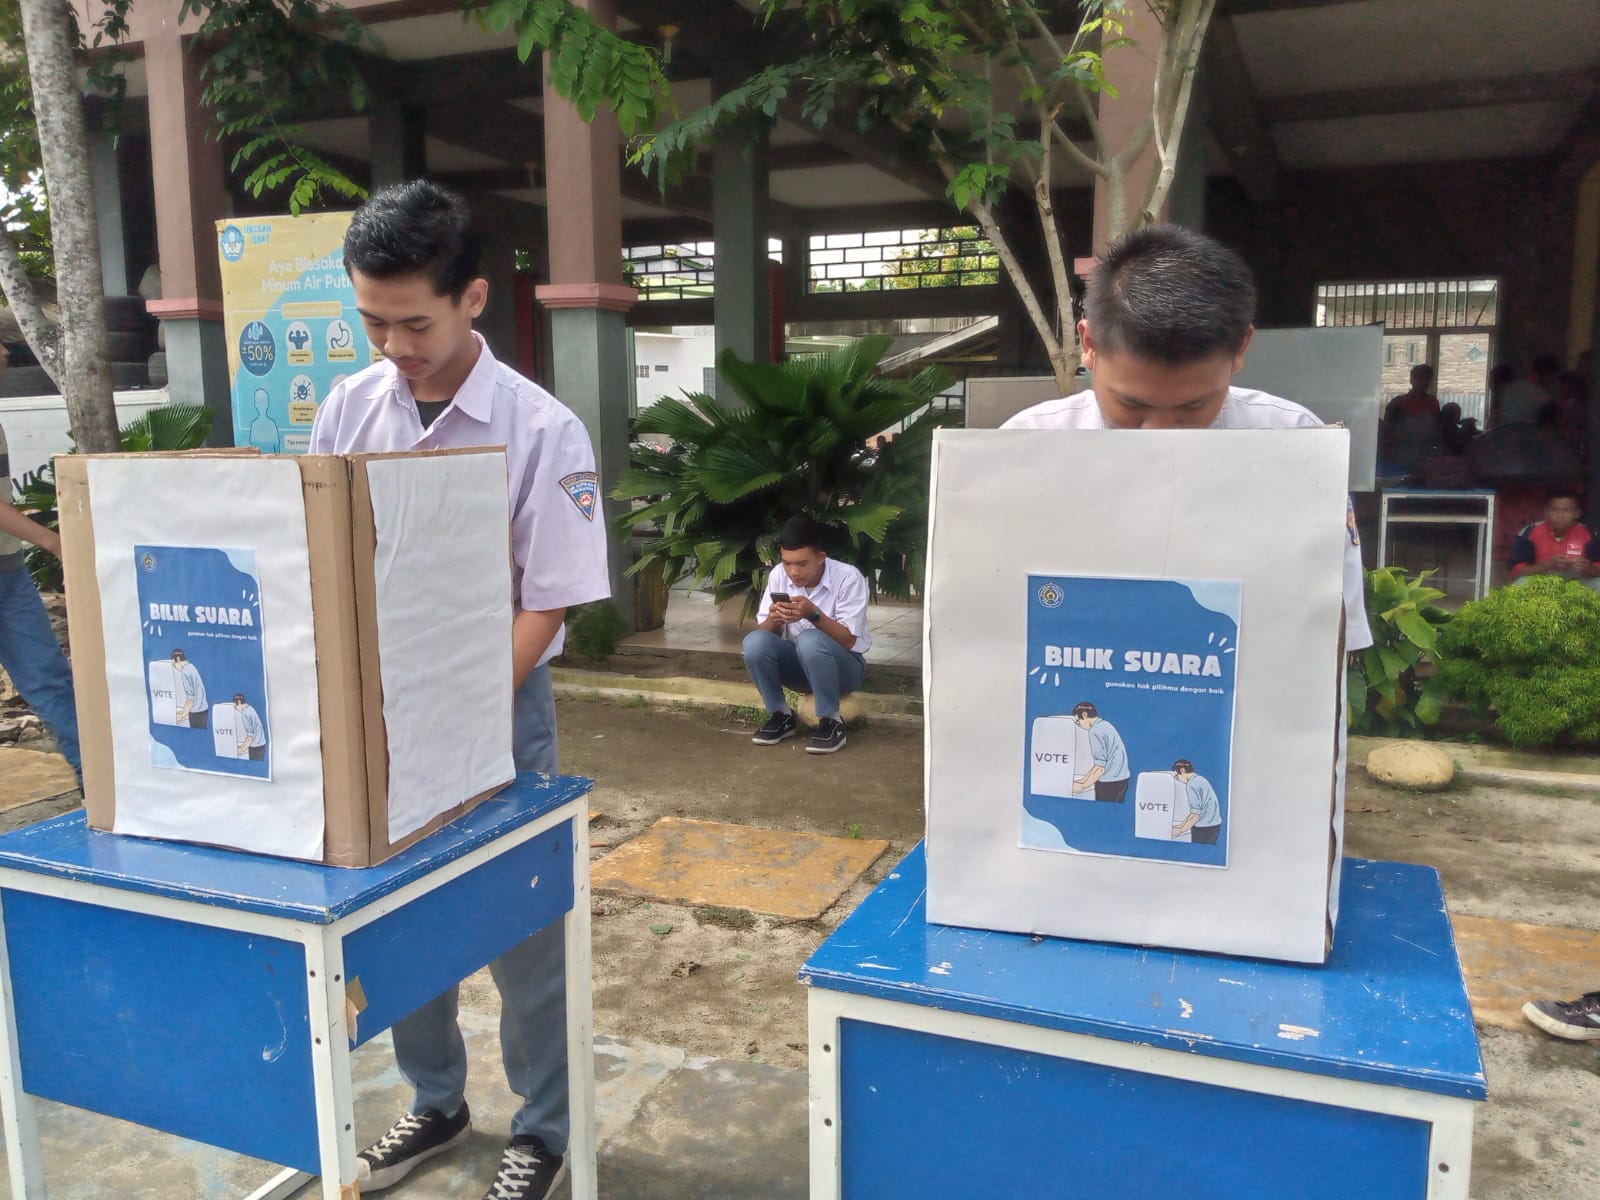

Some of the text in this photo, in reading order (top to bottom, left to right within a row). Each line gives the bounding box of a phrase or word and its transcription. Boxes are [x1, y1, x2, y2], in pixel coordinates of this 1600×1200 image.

[268, 255, 345, 276] Ayo Biasaka
[261, 273, 353, 292] Minum Air Puti
[149, 602, 254, 627] BILIK SUARA
[1045, 645, 1222, 677] BILIK SUARA
[153, 689, 173, 699] VOTE
[1105, 681, 1136, 689] gunakan
[1152, 683, 1179, 691] pilihmu
[1180, 685, 1207, 694] dengan
[215, 728, 233, 736] VOTE
[1035, 752, 1069, 764] VOTE
[1139, 802, 1169, 812] VOTE
